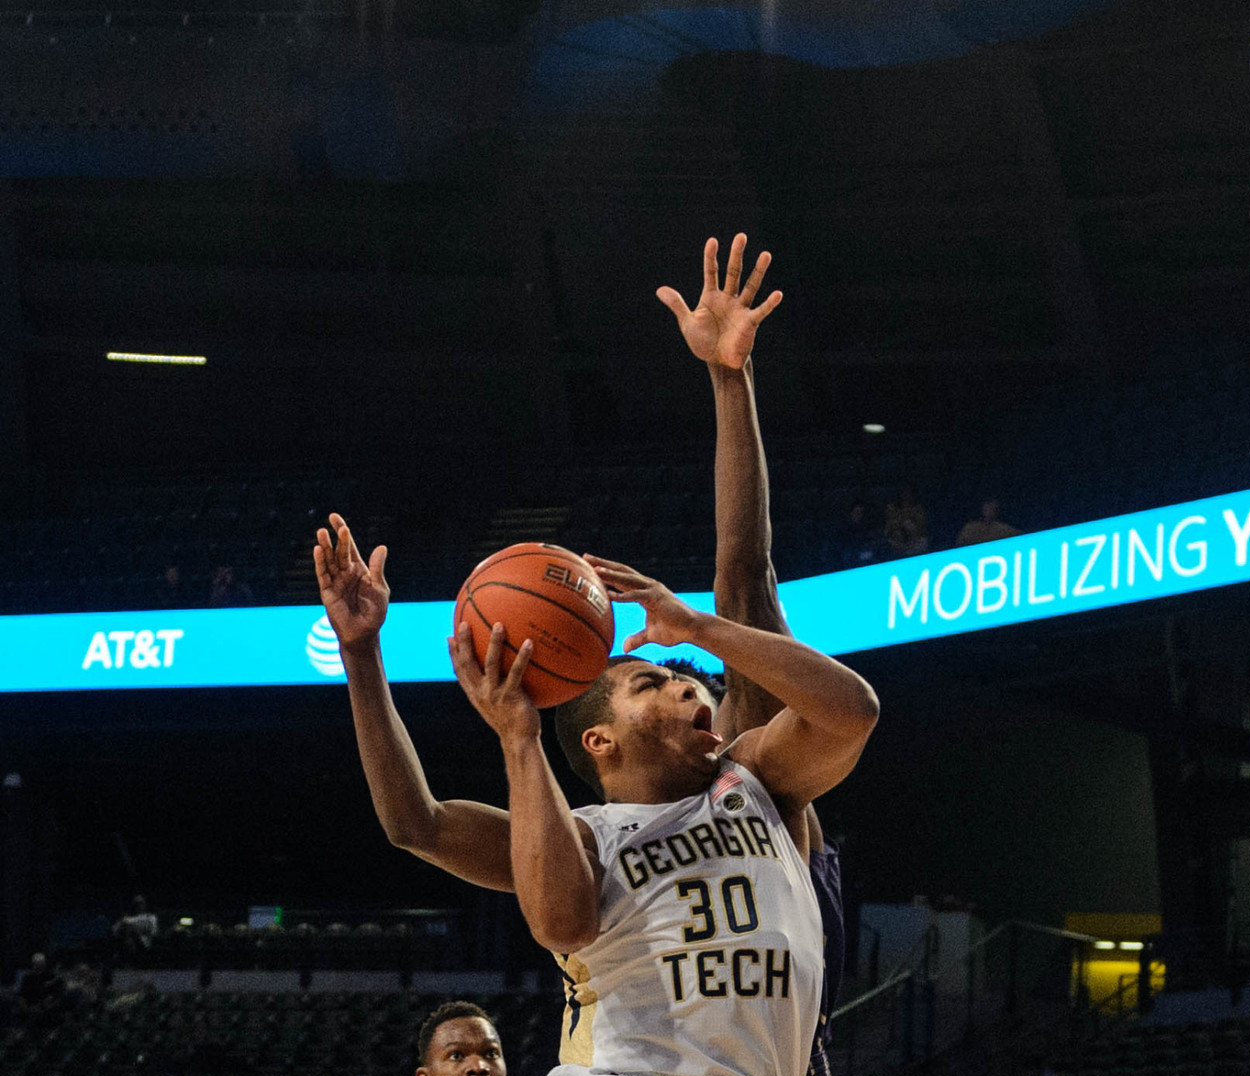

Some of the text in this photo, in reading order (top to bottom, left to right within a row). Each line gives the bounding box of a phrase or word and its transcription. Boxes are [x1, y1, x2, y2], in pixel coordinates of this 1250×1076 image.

[888, 516, 1207, 629] MOBILIZING
[82, 629, 184, 670] AT&T
[618, 816, 782, 891] GEORGIA
[675, 874, 762, 944] 30
[661, 947, 791, 1001] TECH
